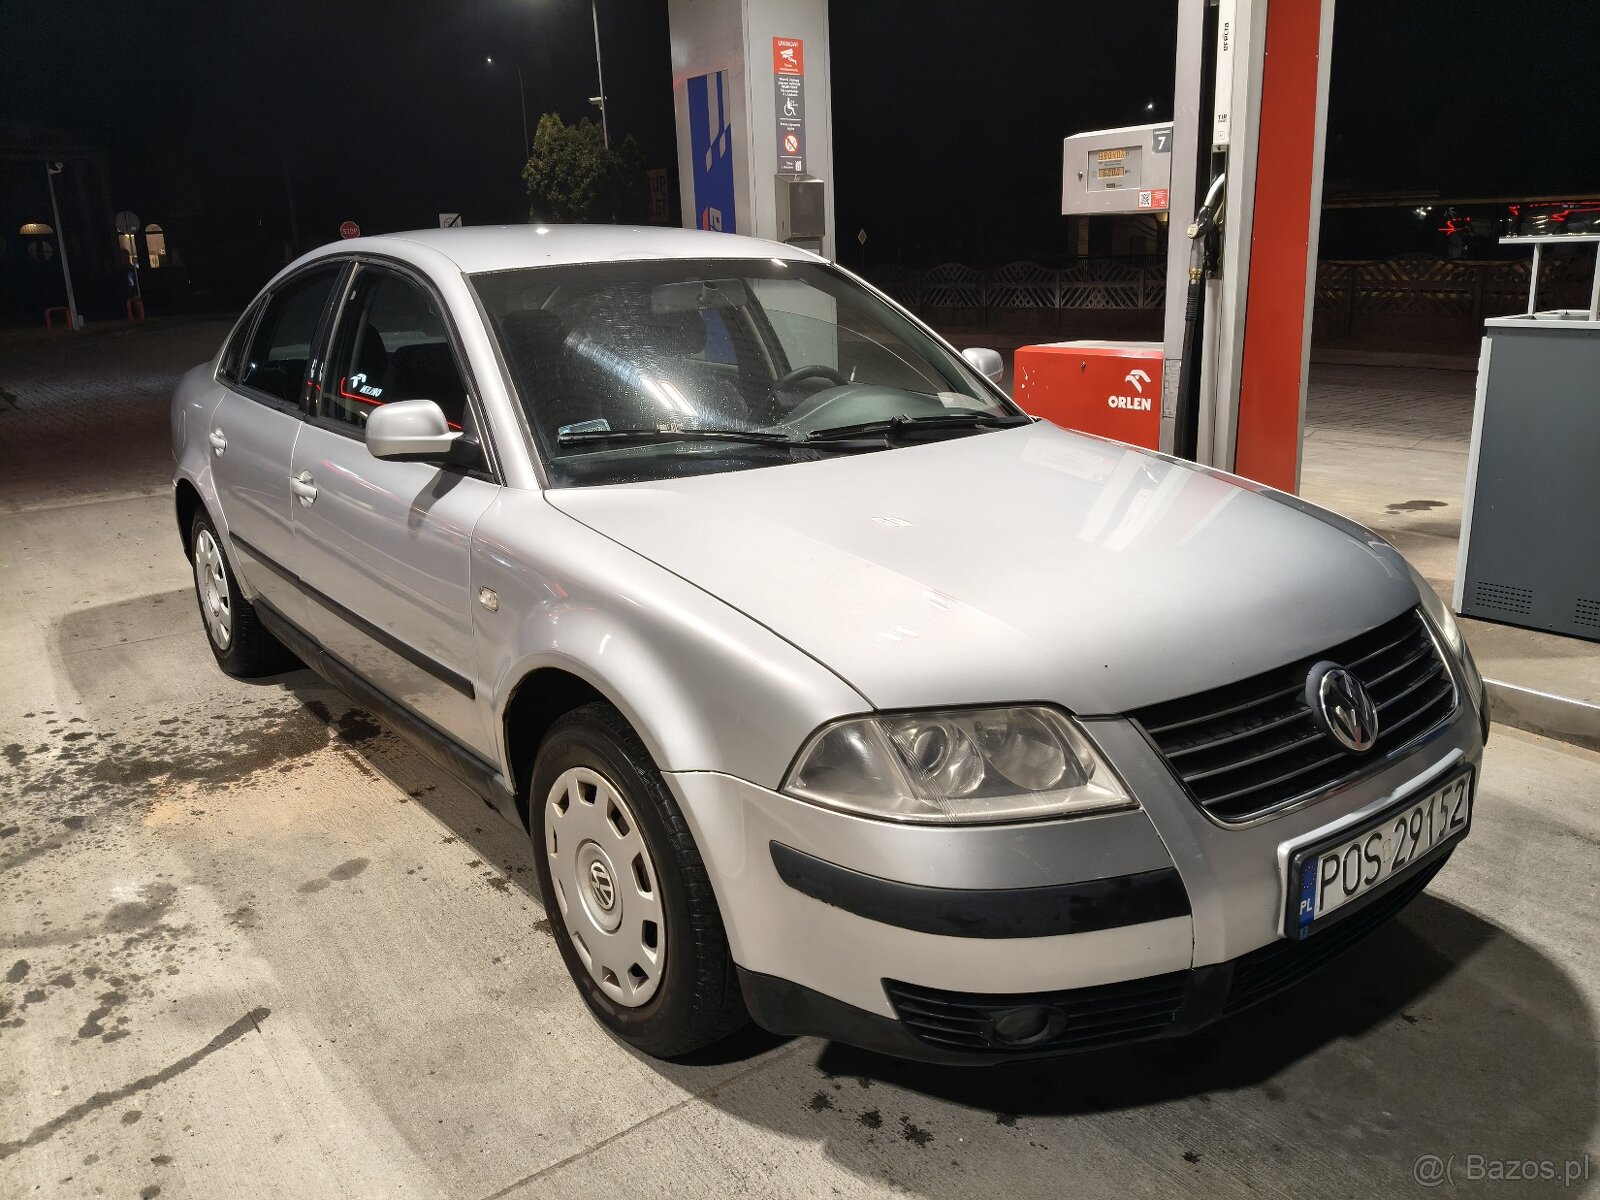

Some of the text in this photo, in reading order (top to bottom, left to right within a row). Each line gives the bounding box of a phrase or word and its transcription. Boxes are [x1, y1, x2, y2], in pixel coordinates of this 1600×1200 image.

[1158, 136, 1166, 150] 7
[1108, 395, 1151, 411] ORLEN
[1318, 778, 1466, 912] POS 29152
[1300, 898, 1312, 915] PL
